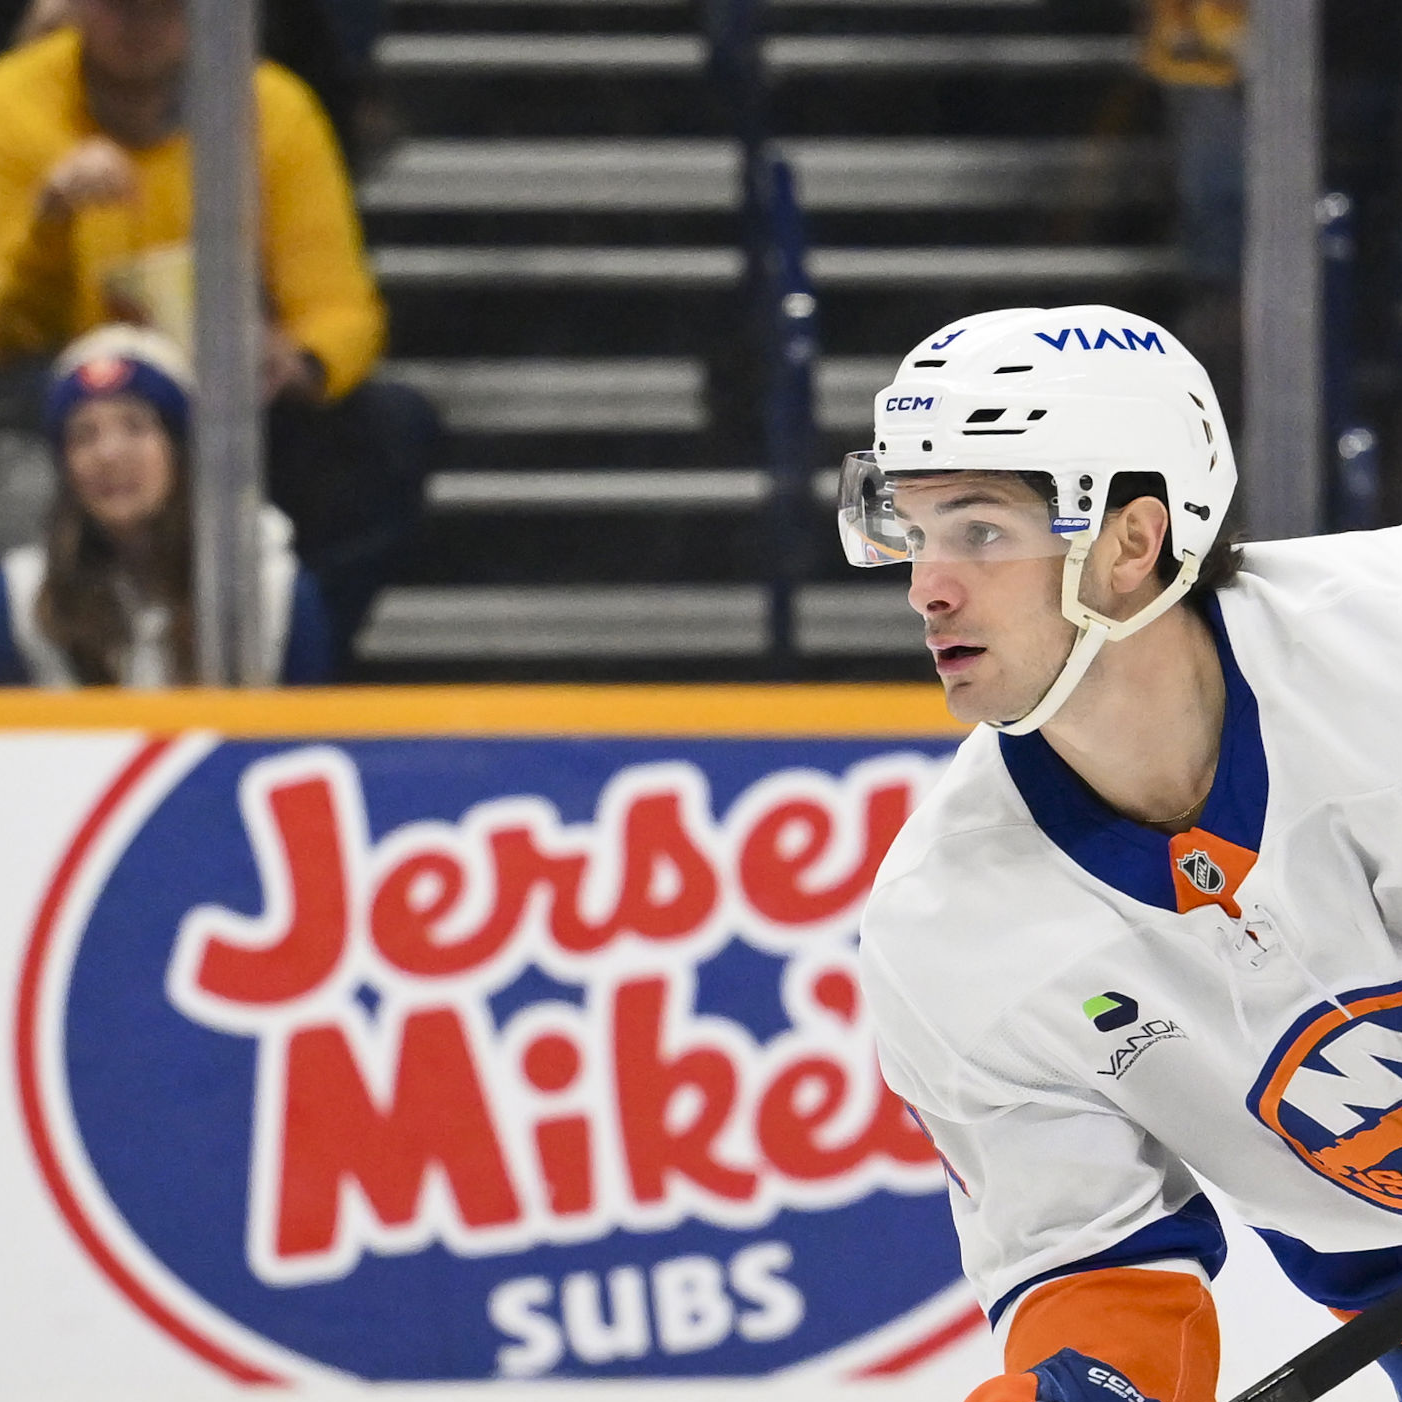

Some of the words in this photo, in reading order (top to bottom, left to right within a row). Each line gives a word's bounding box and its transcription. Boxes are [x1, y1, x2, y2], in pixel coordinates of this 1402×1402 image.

[1034, 328, 1166, 354] VIAM
[886, 397, 934, 411] CCM
[1097, 1020, 1186, 1075] VANDA
[490, 1246, 805, 1378] SUBS
